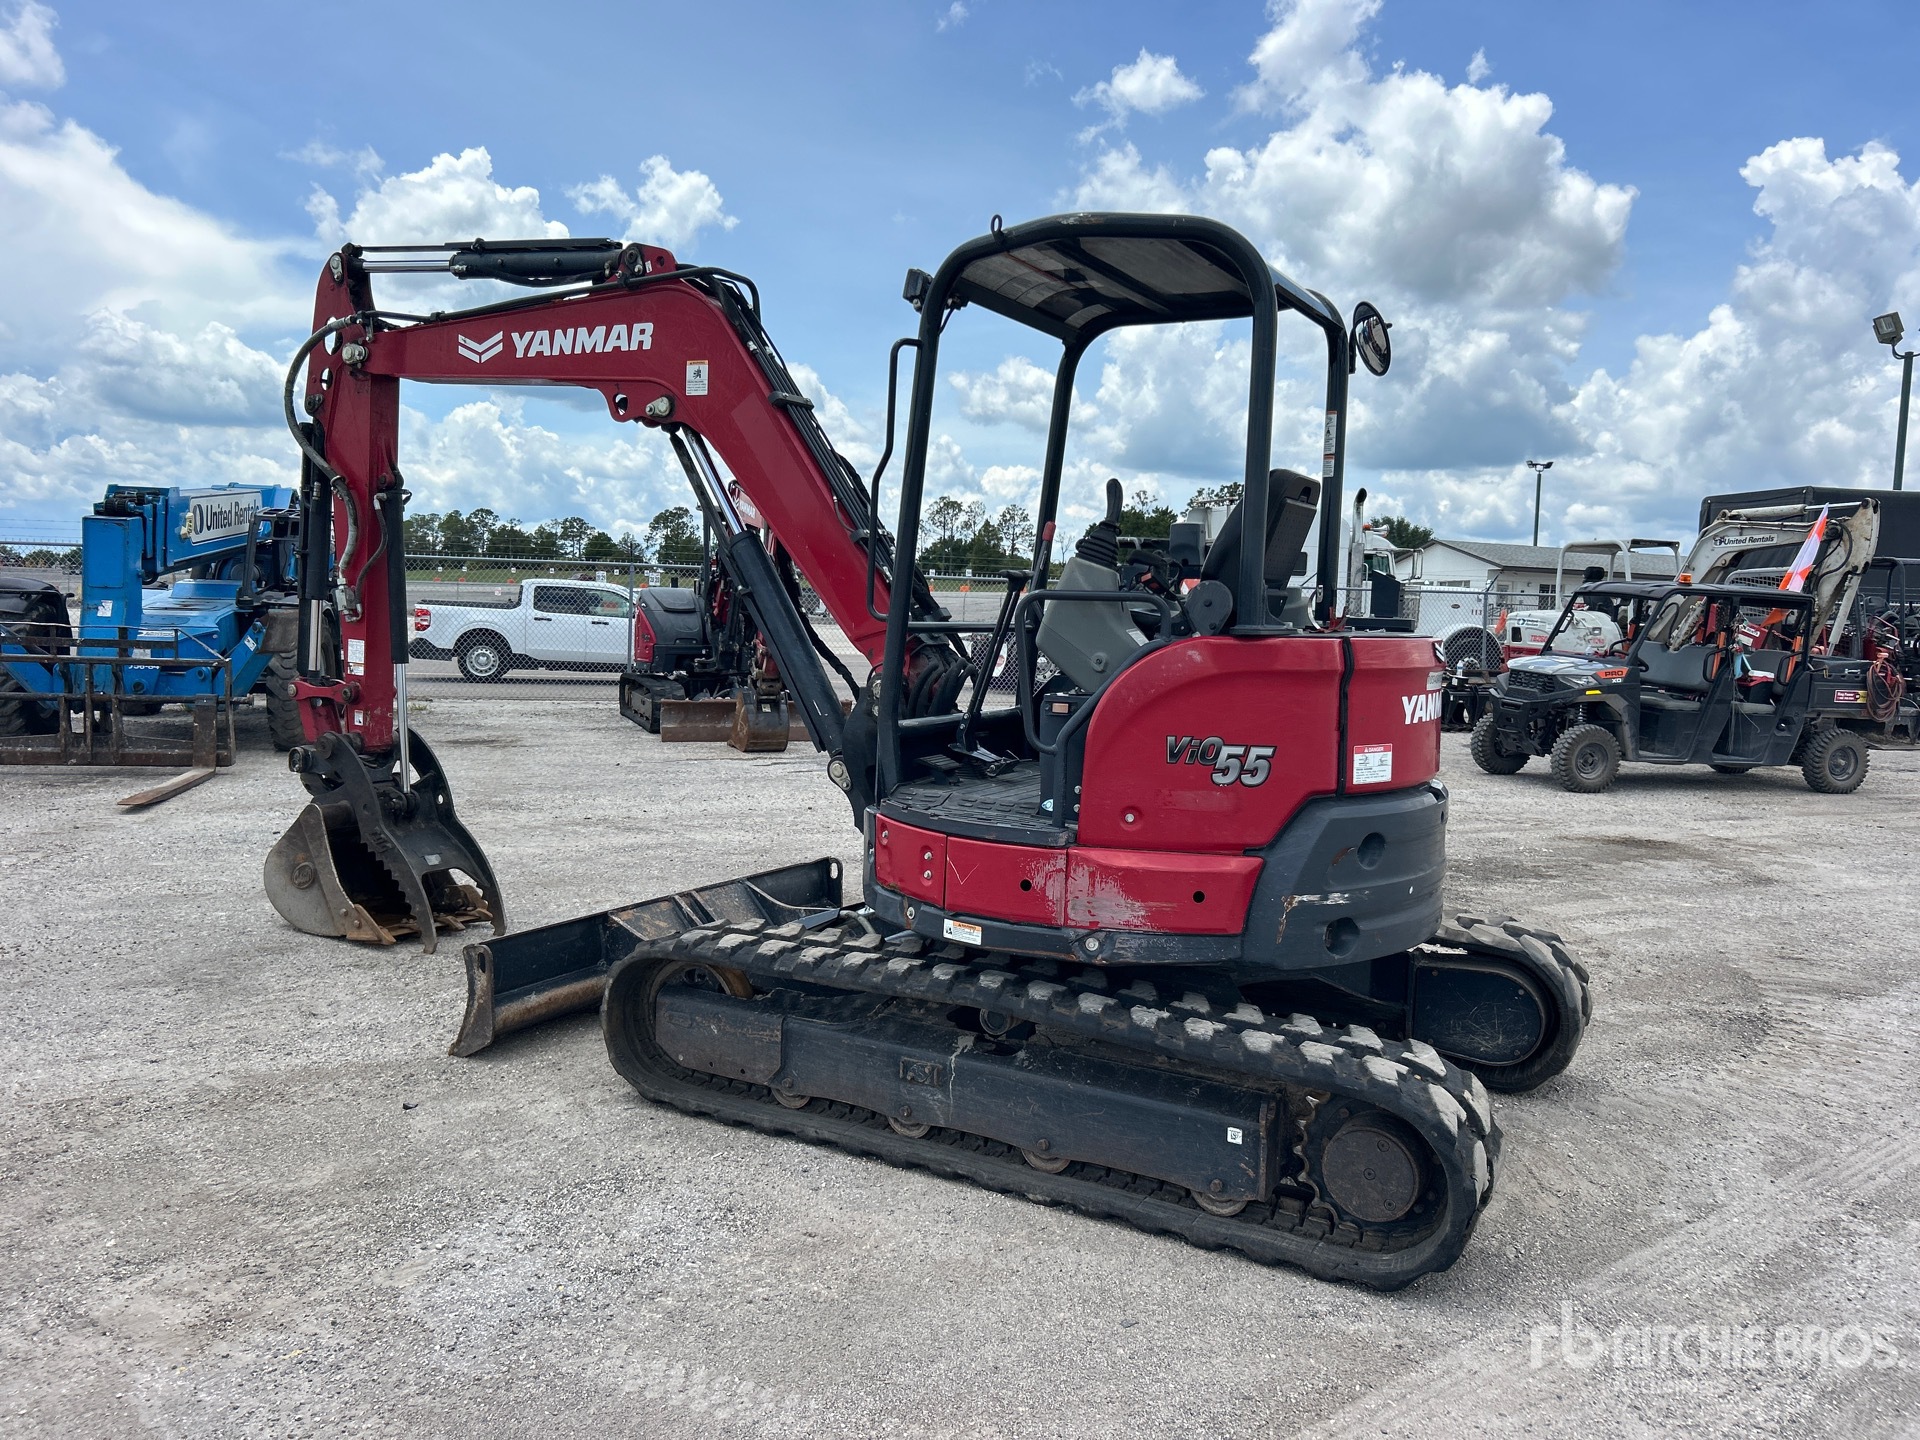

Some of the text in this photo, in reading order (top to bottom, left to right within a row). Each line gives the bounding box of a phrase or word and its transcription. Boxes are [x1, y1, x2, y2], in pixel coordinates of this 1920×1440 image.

[511, 322, 654, 359] YANMAR
[205, 502, 233, 532] United
[1724, 534, 1775, 546] United Rentals
